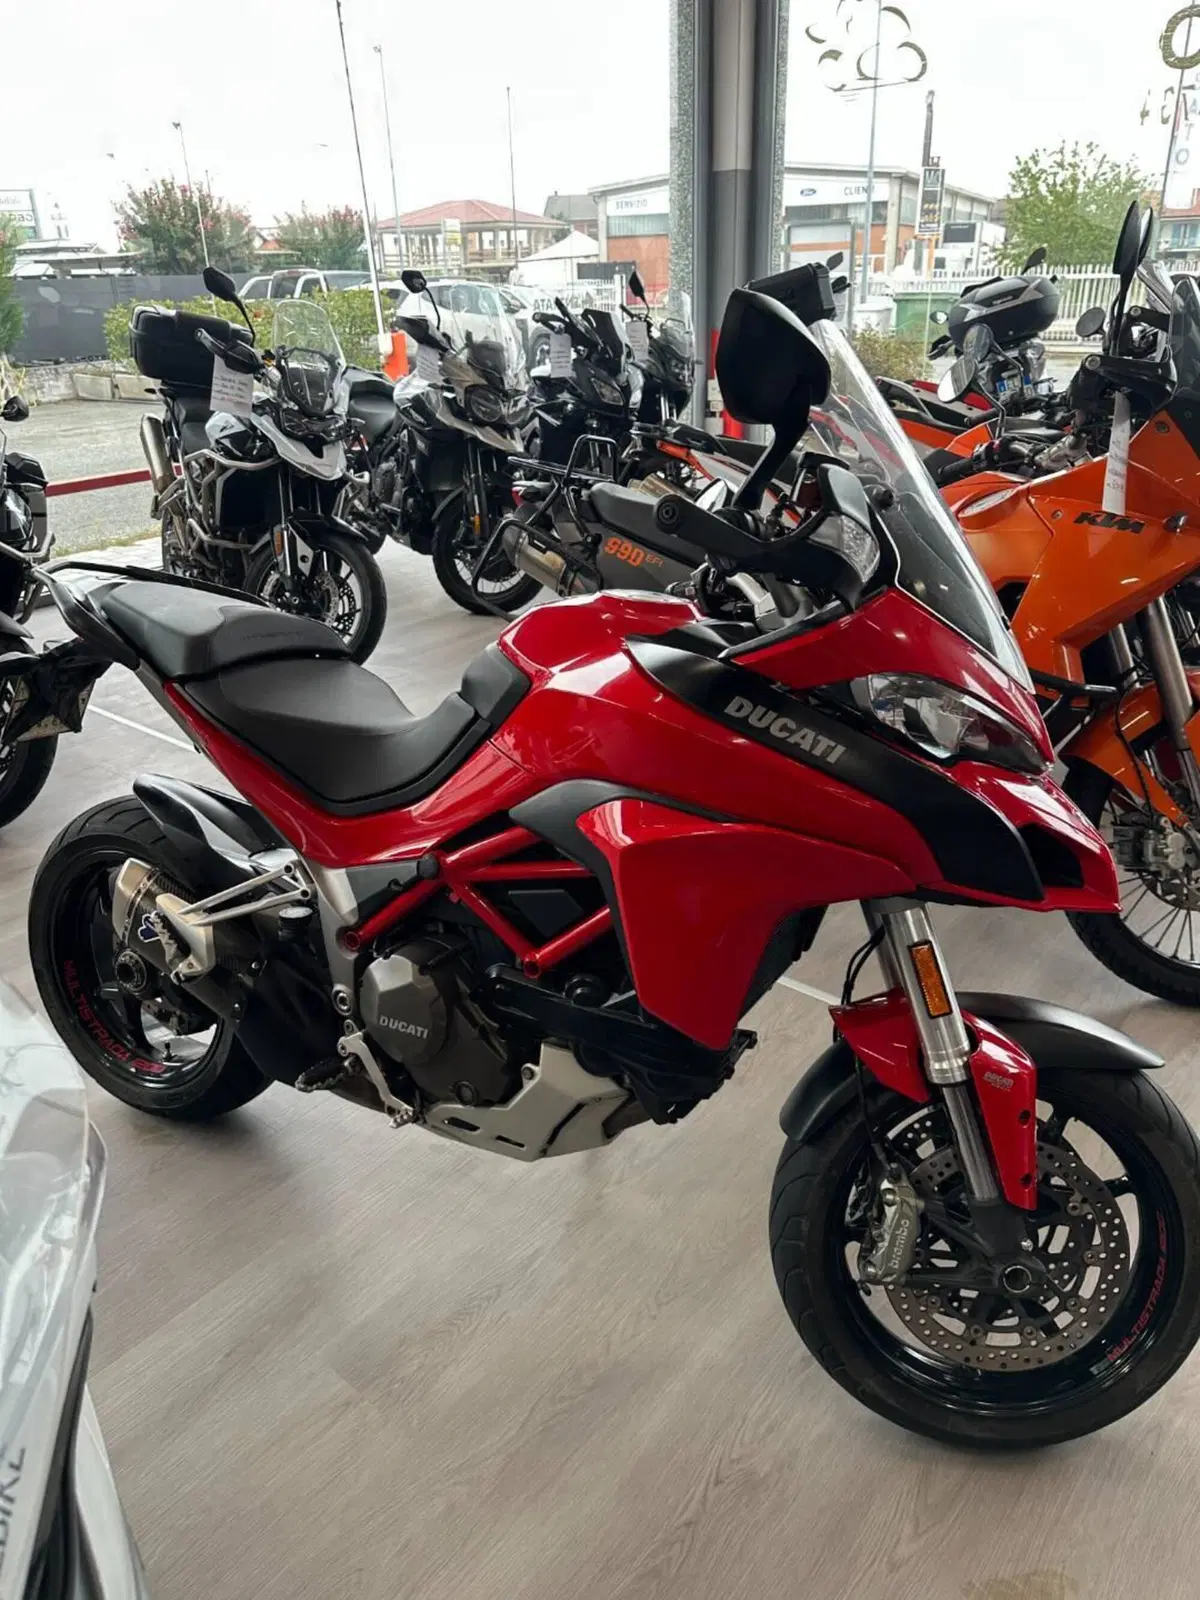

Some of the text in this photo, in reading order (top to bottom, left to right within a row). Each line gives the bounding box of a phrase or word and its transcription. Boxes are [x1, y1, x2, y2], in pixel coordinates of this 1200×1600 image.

[1073, 511, 1145, 534] KTM
[603, 536, 645, 567] 990
[724, 696, 846, 764] DUCATI
[379, 1014, 429, 1040] DUCATI
[888, 1219, 910, 1269] brembo
